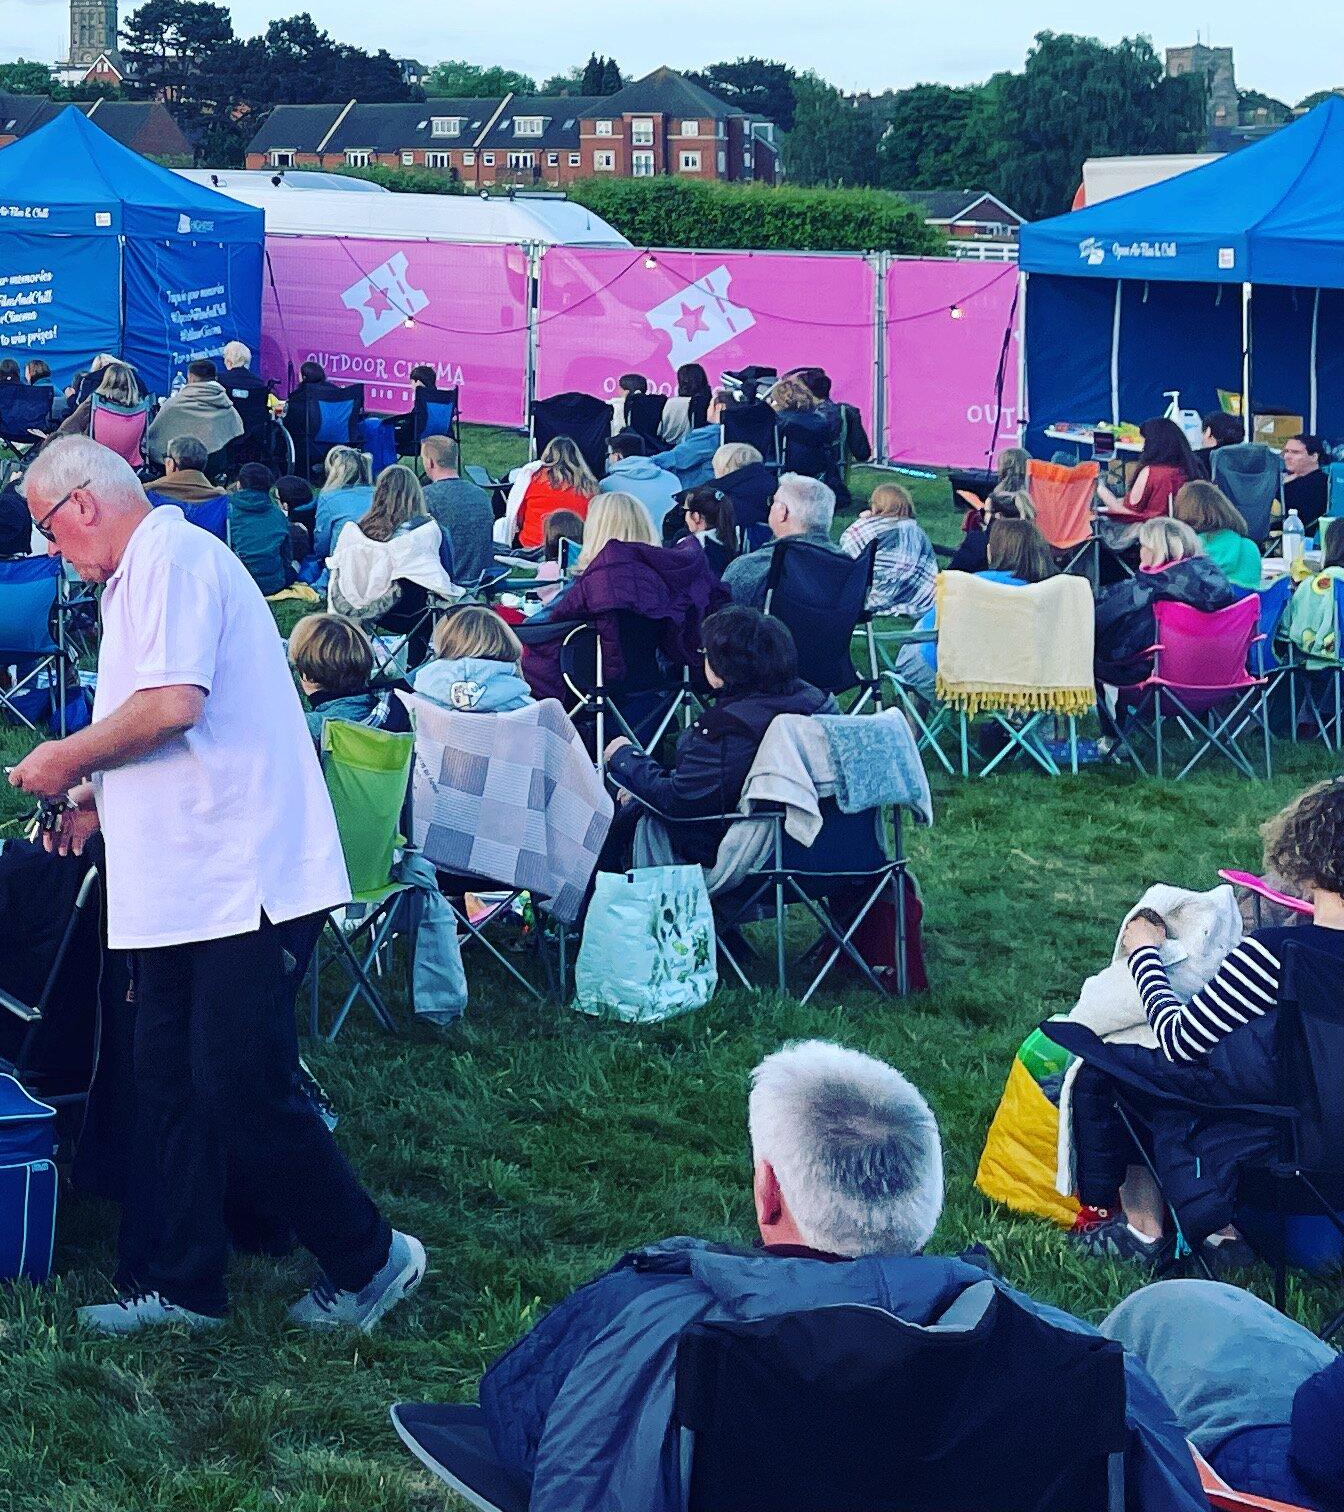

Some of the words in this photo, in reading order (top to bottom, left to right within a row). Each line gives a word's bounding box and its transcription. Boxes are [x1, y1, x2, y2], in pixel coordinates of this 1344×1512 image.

[9, 269, 54, 286] memories
[0, 333, 10, 346] to
[10, 330, 27, 345] win
[27, 324, 58, 347] prizes!
[393, 359, 465, 386] CIMA
